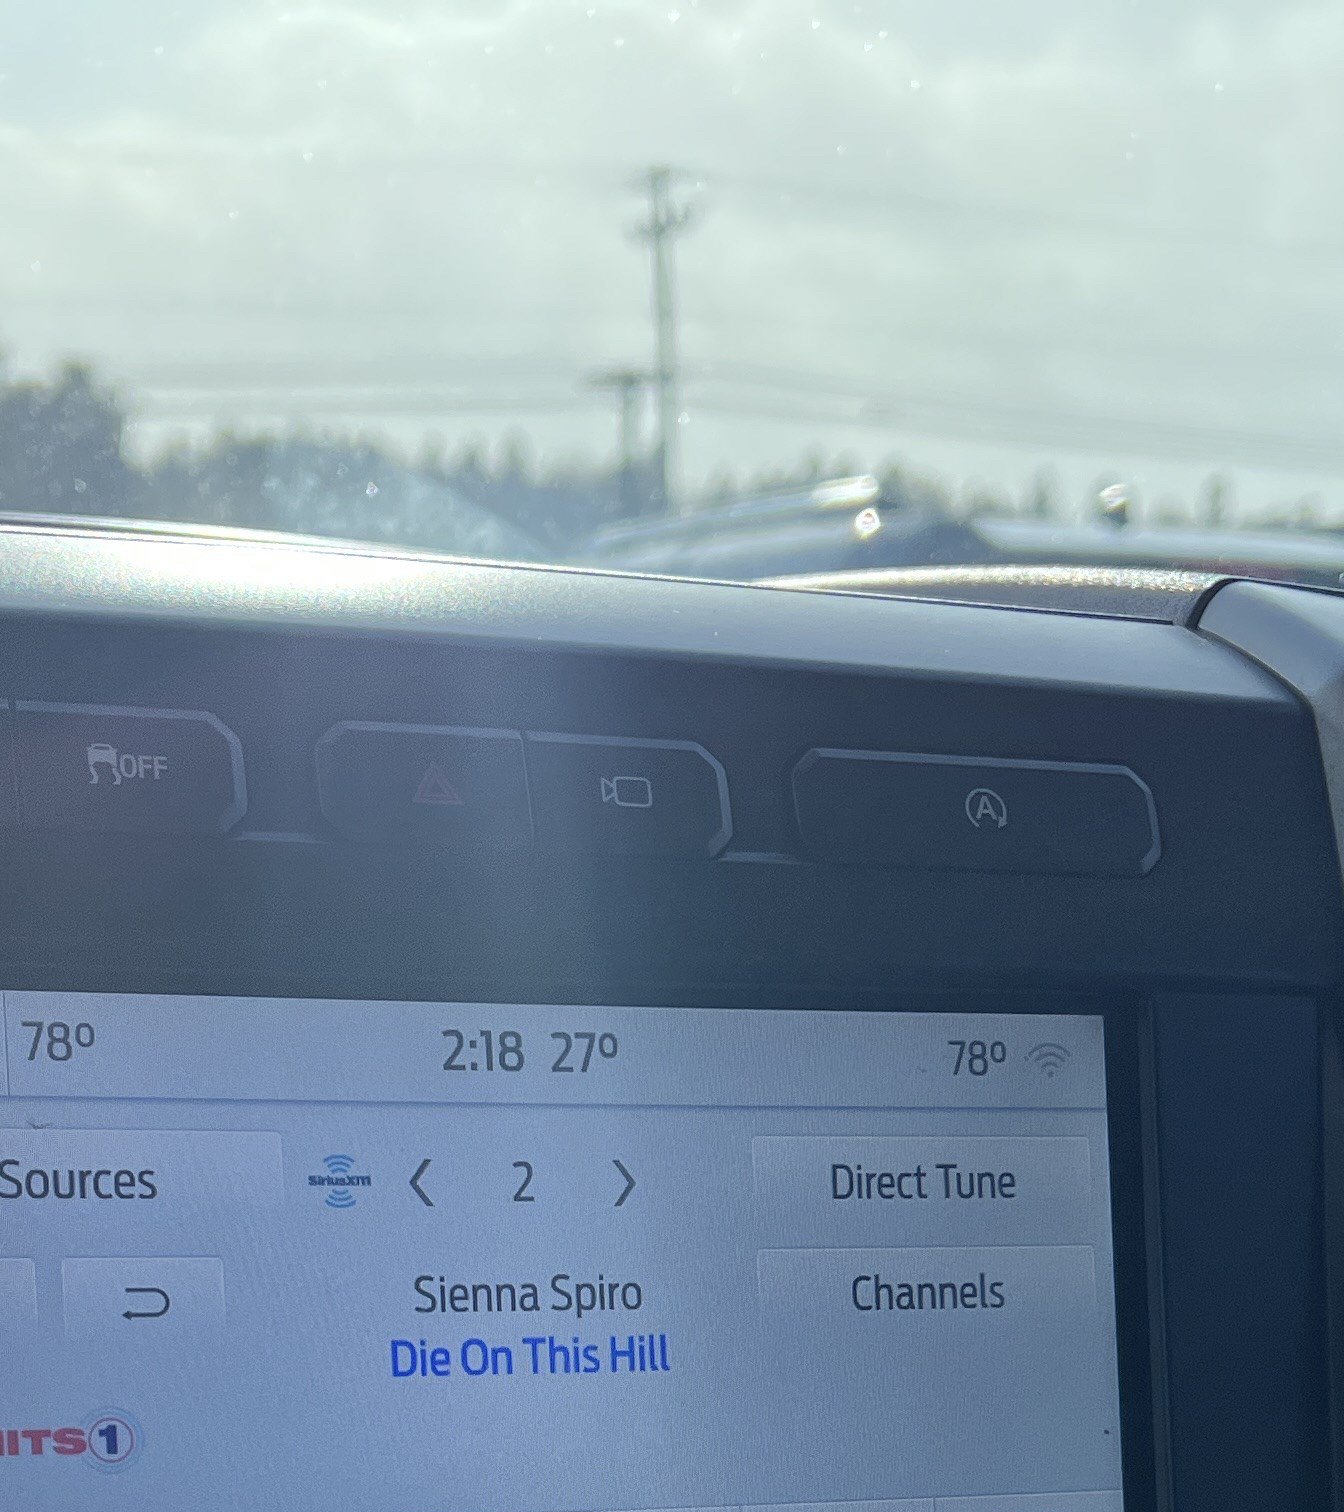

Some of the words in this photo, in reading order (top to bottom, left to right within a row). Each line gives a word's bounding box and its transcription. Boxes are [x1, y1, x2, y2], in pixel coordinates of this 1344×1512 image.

[119, 754, 169, 781] OFF
[442, 1030, 524, 1071] 2:18
[513, 1162, 534, 1201] 2
[832, 1164, 927, 1199] Direct
[936, 1164, 1015, 1199] Tune
[415, 1276, 540, 1312] Sienna
[551, 1275, 641, 1318] Spiro
[853, 1273, 1004, 1310] Channels
[391, 1340, 450, 1377] Die
[461, 1339, 512, 1375] On
[522, 1336, 600, 1374] This
[611, 1334, 670, 1372] Hill
